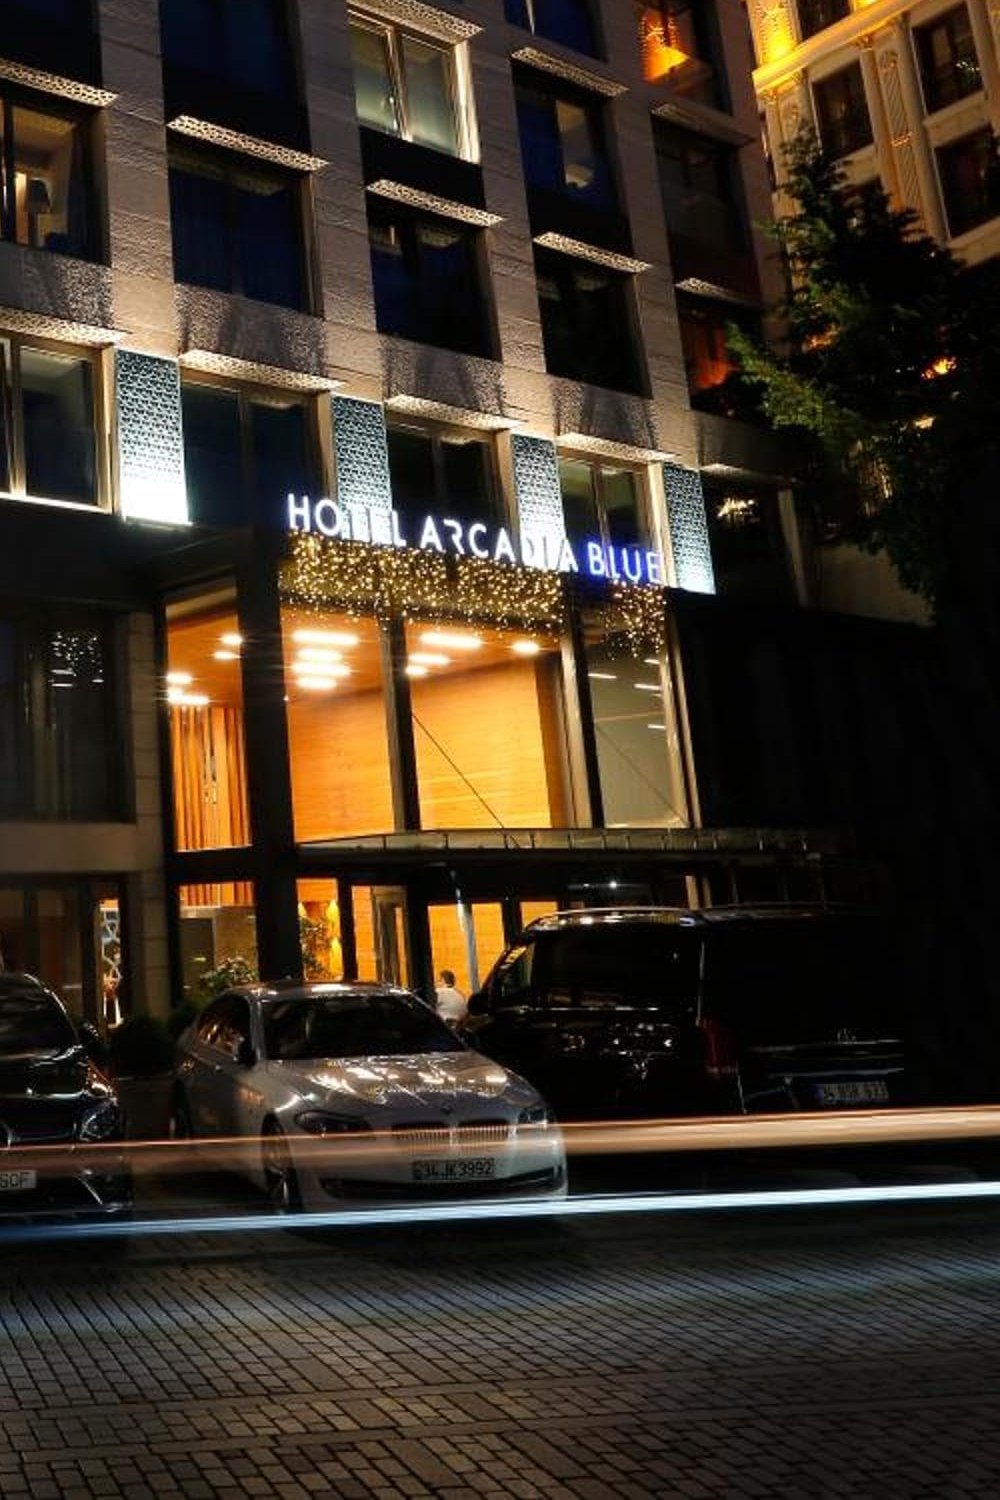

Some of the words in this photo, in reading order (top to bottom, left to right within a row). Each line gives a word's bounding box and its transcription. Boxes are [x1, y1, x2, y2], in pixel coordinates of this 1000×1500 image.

[288, 494, 407, 547] HOTEL
[420, 515, 579, 572] ARCADIA
[587, 541, 662, 583] BLUE
